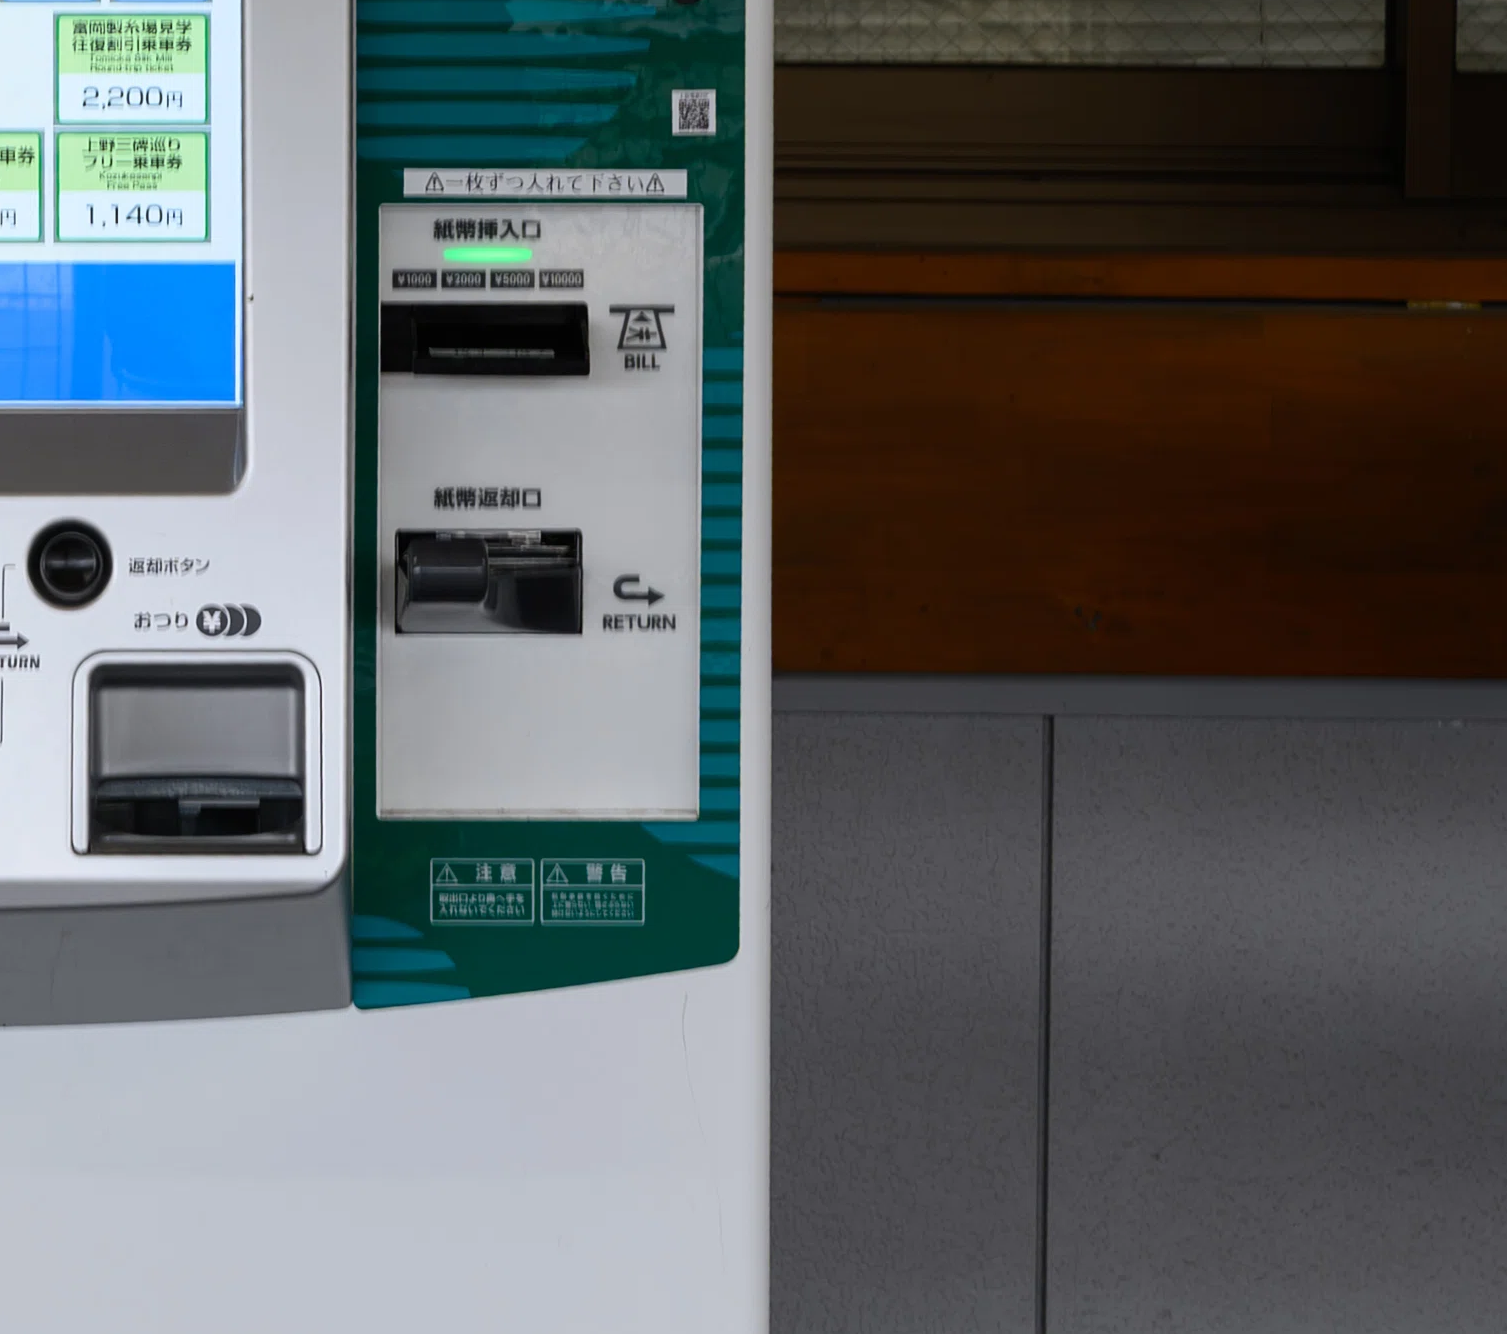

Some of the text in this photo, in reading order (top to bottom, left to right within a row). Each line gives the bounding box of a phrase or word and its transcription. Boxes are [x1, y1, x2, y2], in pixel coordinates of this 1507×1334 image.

[82, 86, 184, 111] 2,200円
[445, 172, 644, 193] 一枚ずつ入れて下さい
[86, 203, 184, 230] 1,140円
[433, 218, 542, 242] 紙幣挿入口
[623, 354, 661, 371] BILL
[433, 486, 542, 510] 紙幣返却口
[128, 556, 211, 576] 返却ボタン
[134, 611, 189, 631] おつり
[602, 614, 677, 630] RETURN
[475, 862, 517, 883] 注意
